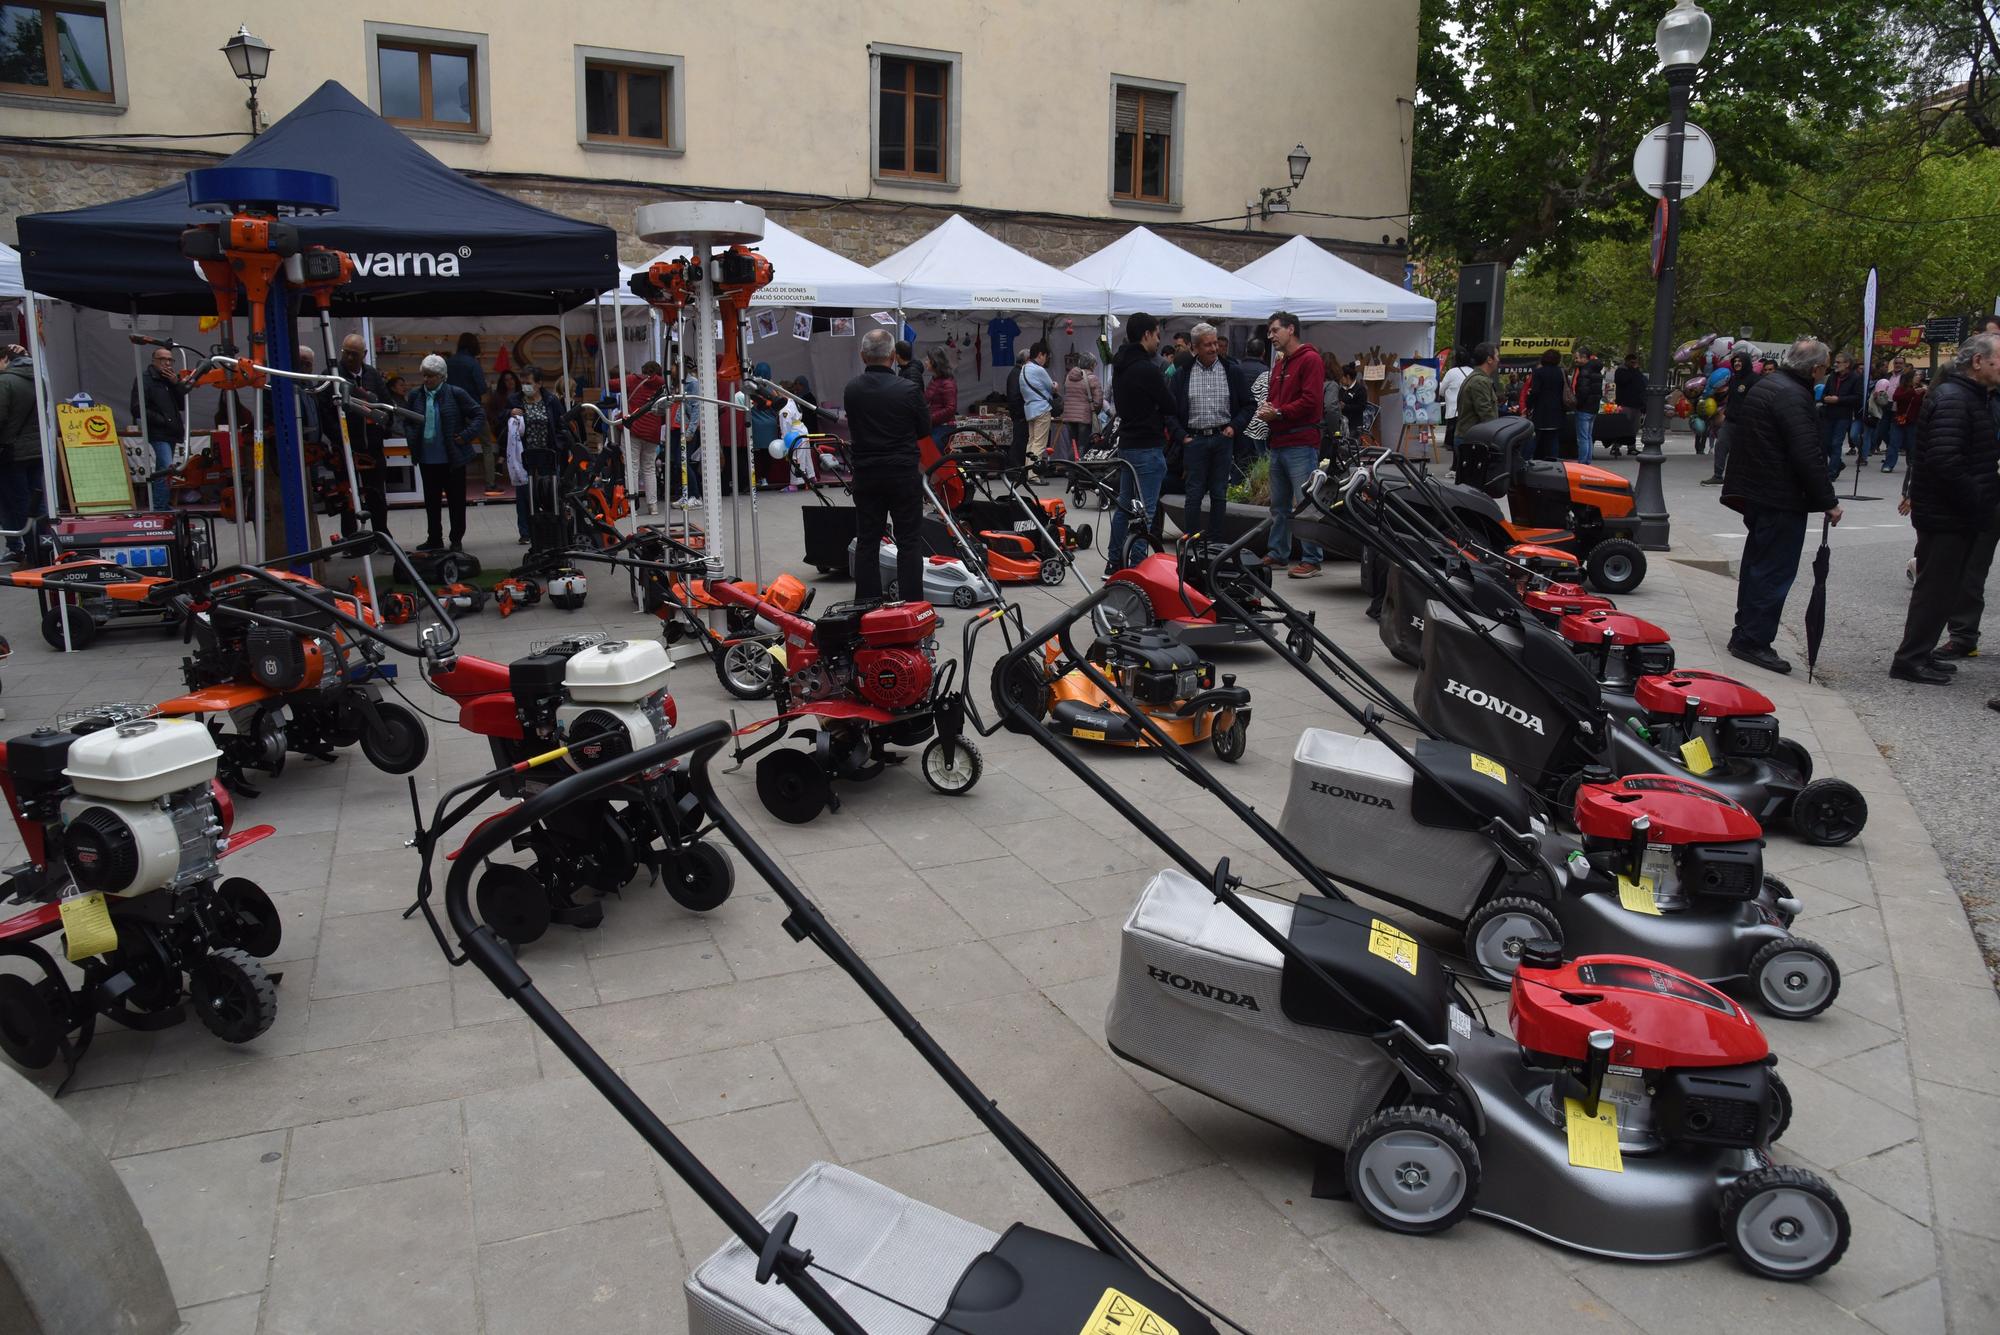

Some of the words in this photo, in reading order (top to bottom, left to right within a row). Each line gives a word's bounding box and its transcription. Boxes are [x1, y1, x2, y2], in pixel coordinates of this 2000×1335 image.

[974, 295, 1000, 303] FUNDACIÓ
[133, 520, 163, 529] 40L
[917, 609, 934, 621] HONDA
[1444, 678, 1545, 736] HONDA
[1310, 780, 1395, 810] HONDA
[1147, 964, 1261, 1012] HONDA
